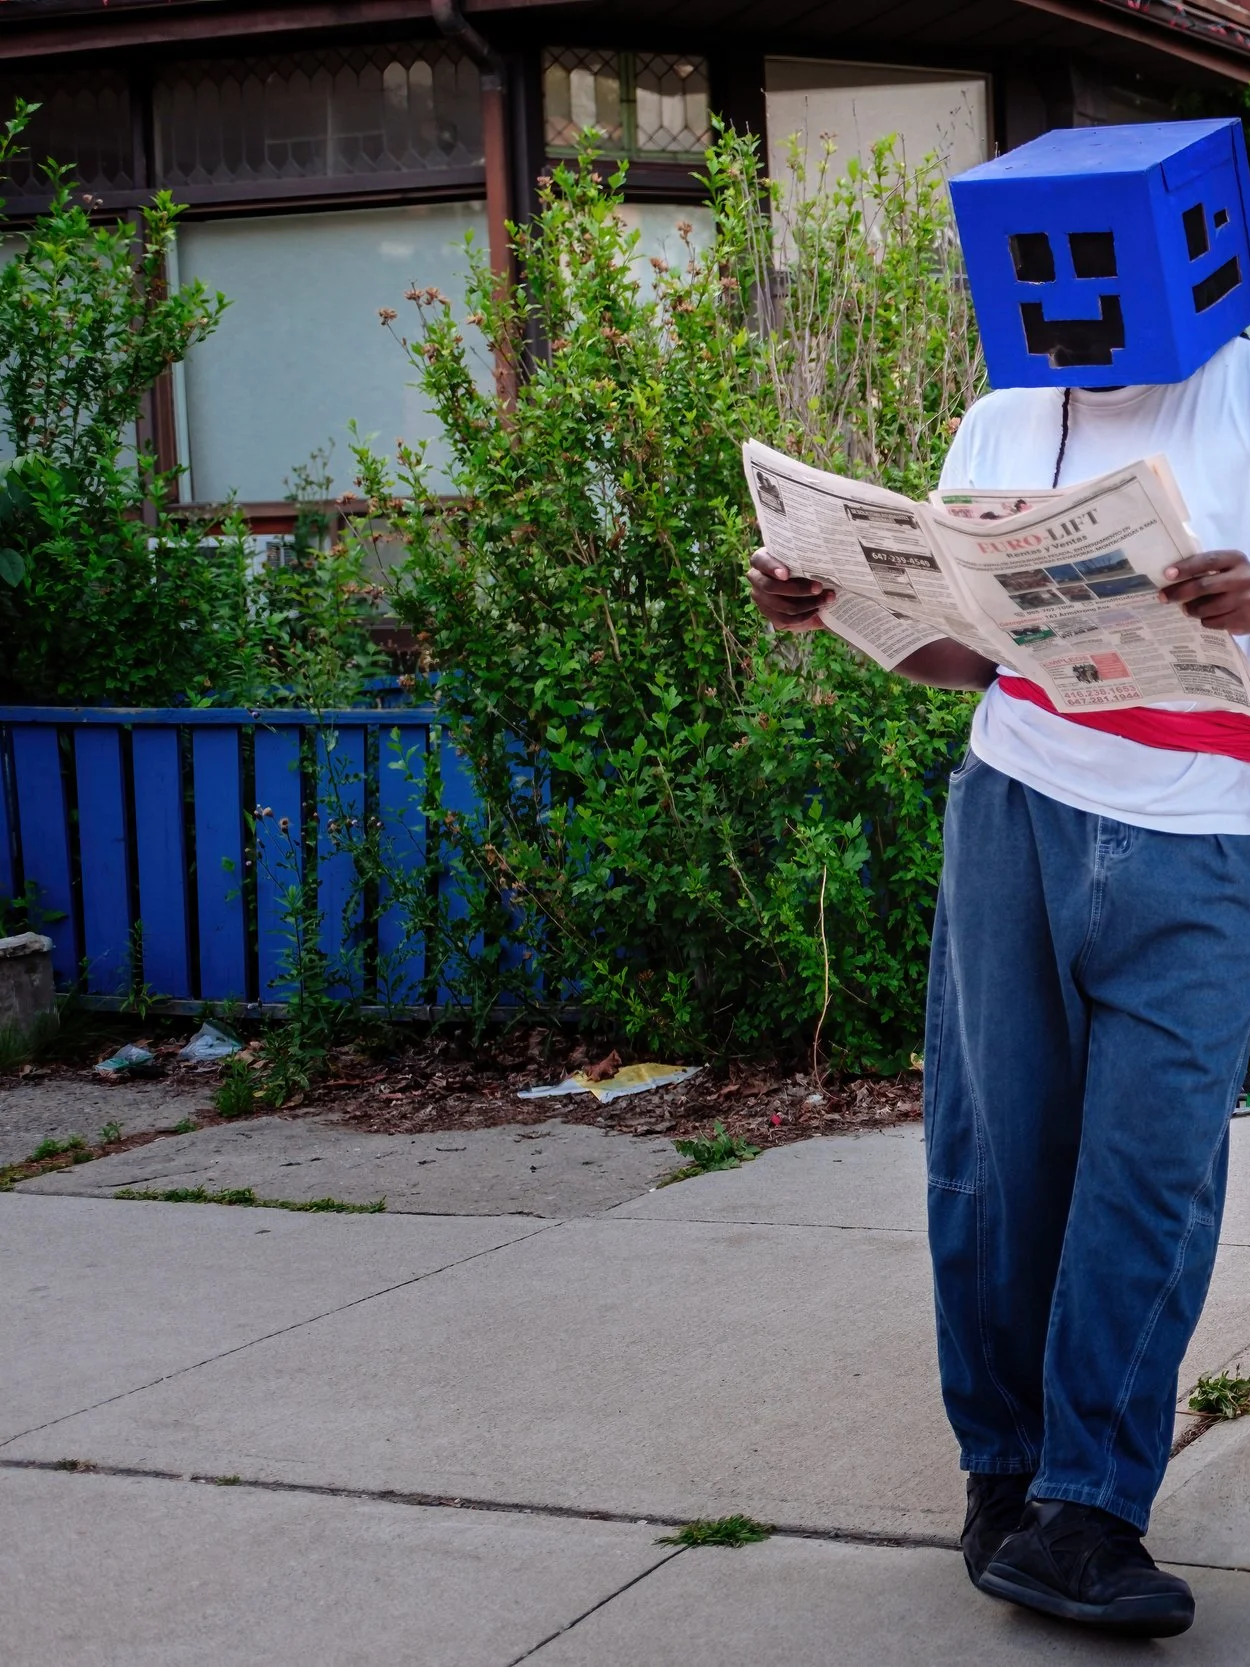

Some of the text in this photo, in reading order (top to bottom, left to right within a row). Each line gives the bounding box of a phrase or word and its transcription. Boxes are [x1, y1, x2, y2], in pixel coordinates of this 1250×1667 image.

[977, 508, 1099, 554] EURO-LIFT
[1006, 549, 1042, 559] Rentas
[1051, 535, 1088, 550] Ventas
